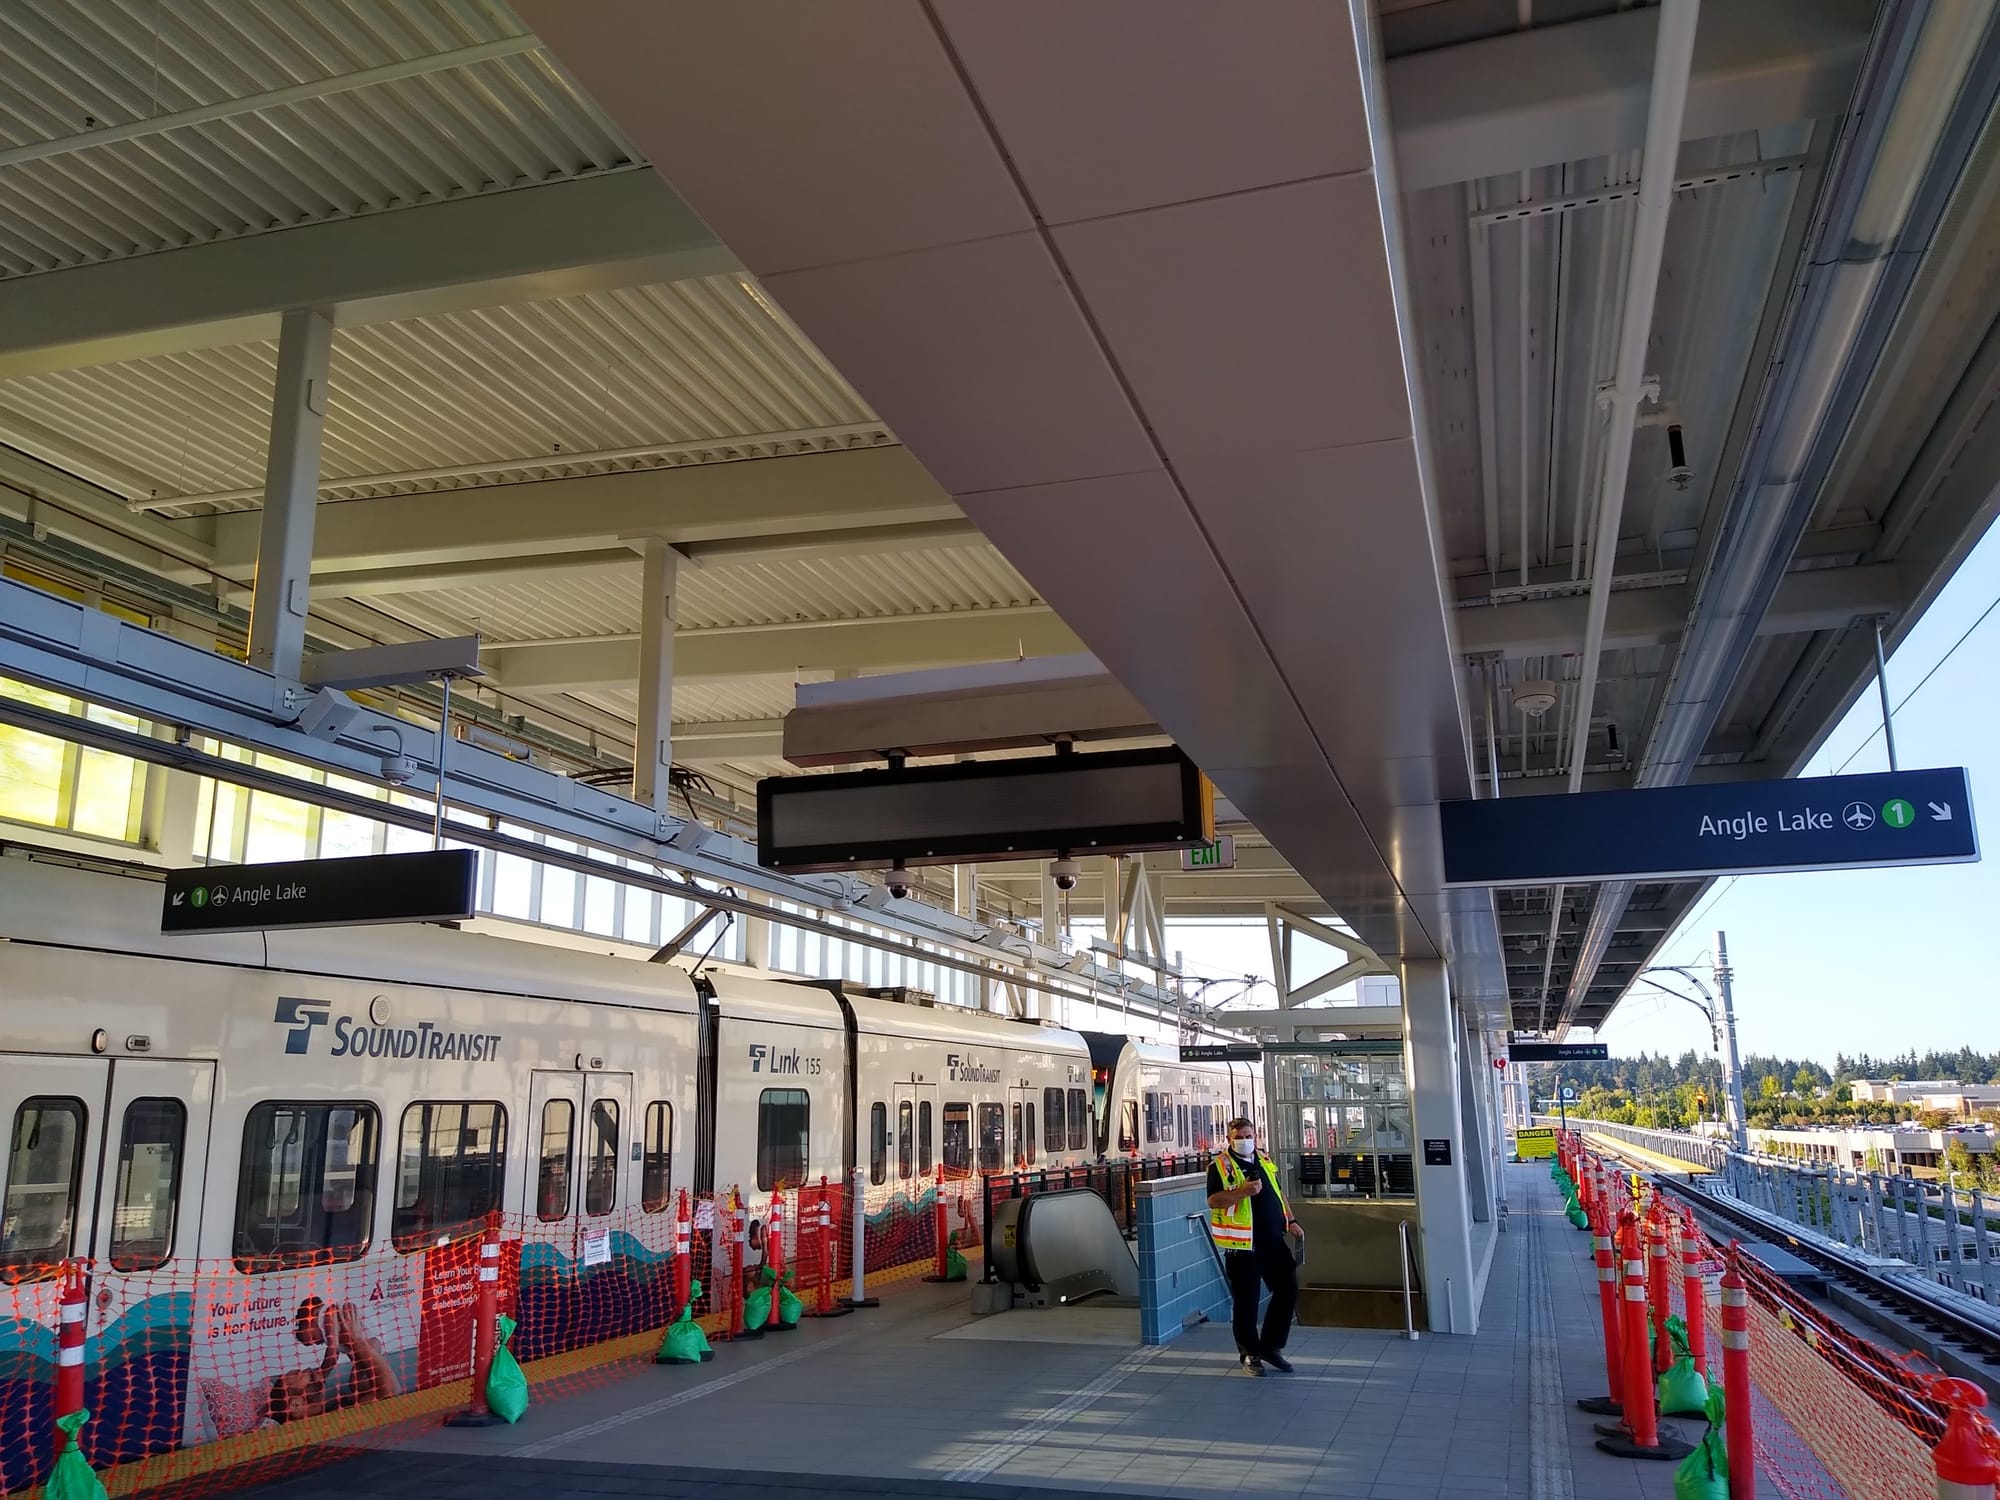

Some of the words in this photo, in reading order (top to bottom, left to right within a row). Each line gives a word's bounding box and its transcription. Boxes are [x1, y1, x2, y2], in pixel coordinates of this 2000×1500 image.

[1698, 810, 1769, 841] Angle
[1777, 807, 1834, 833] Lake
[1191, 840, 1222, 865] EXIT
[231, 884, 272, 906] Angle
[275, 881, 308, 901] Lake
[769, 1045, 801, 1075] Link
[805, 1057, 821, 1075] 155
[1518, 1129, 1552, 1138] DANGER
[434, 1265, 456, 1280] Learn
[457, 1263, 473, 1276] Your
[1697, 1262, 1716, 1273] GER
[211, 1302, 241, 1317] Your
[243, 1296, 281, 1313] future
[207, 1324, 220, 1339] is
[223, 1322, 246, 1337] her
[248, 1315, 290, 1332] future.
